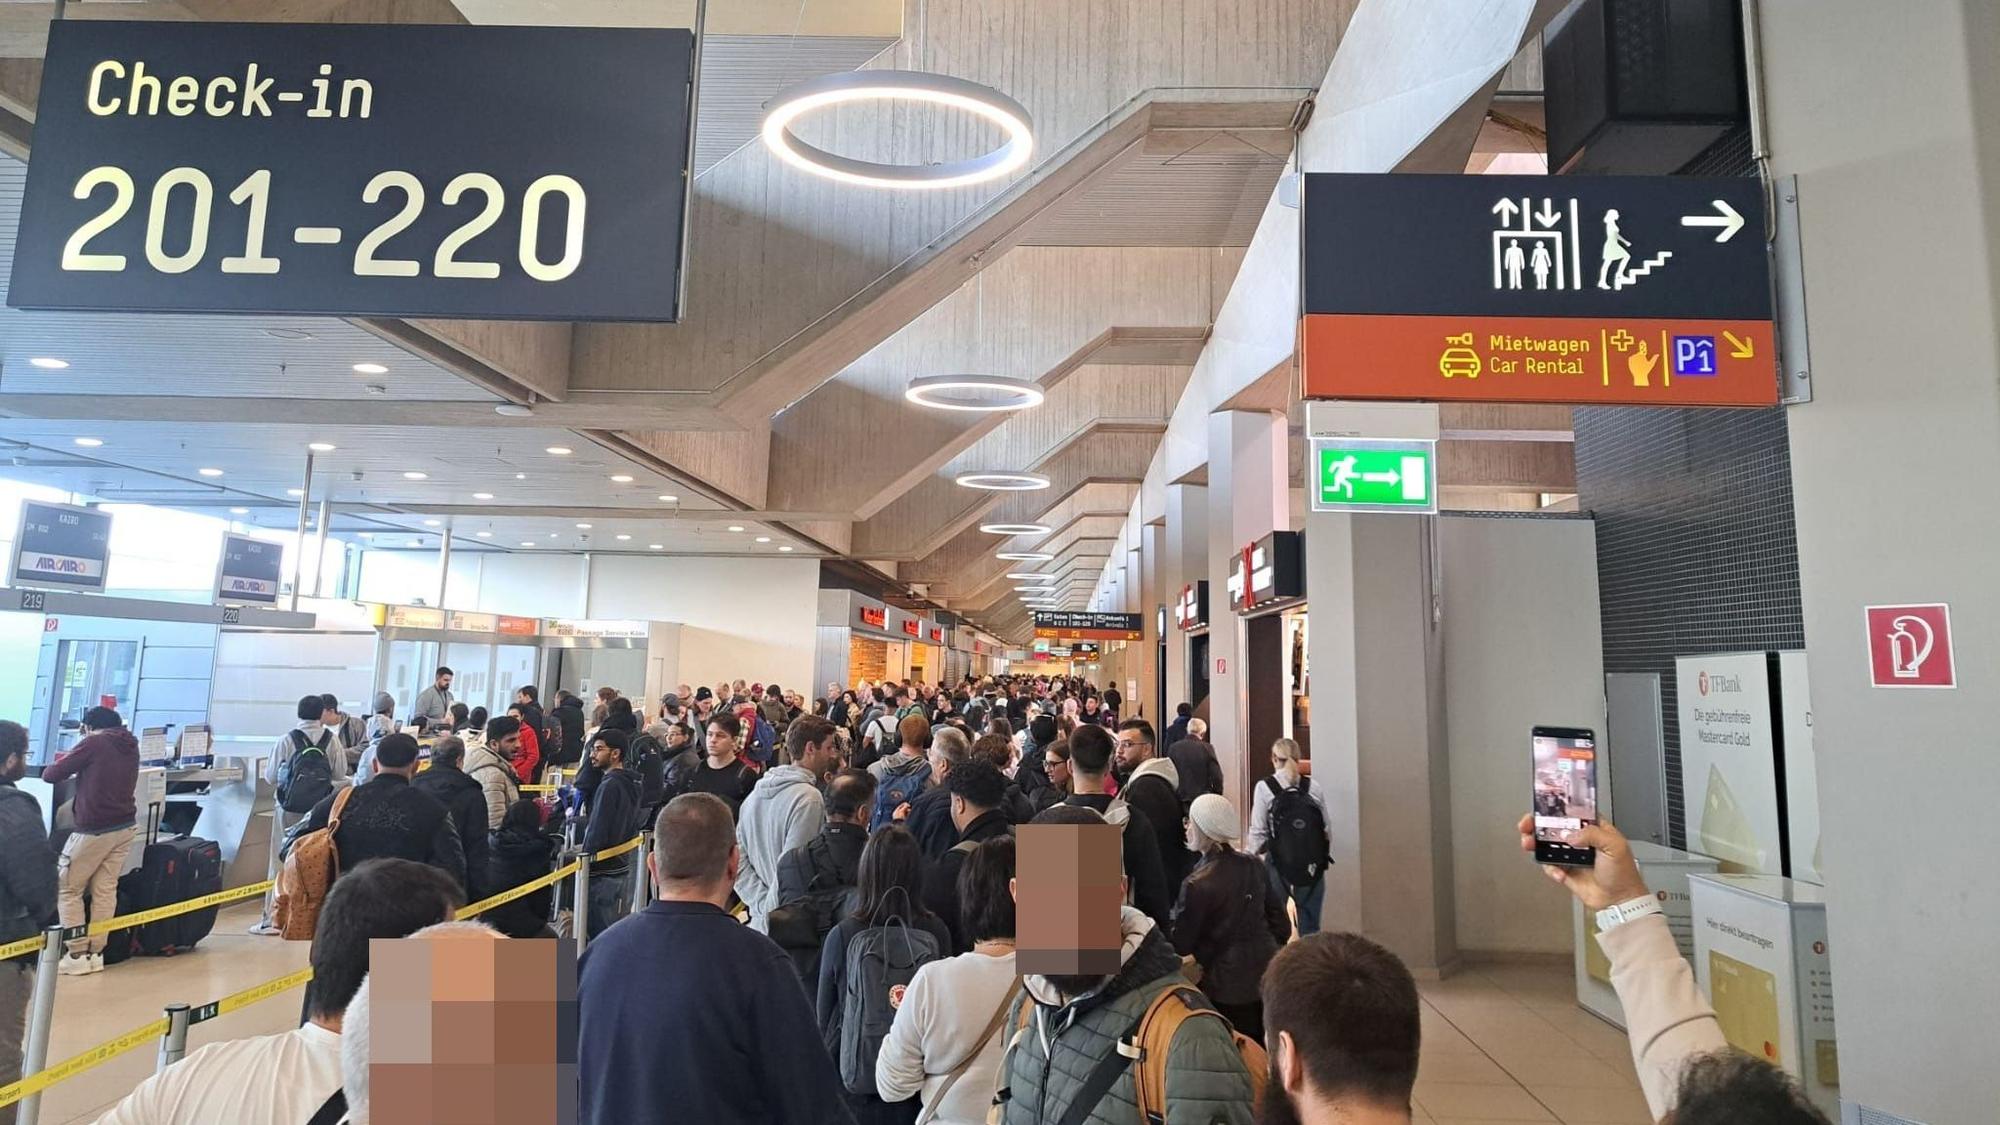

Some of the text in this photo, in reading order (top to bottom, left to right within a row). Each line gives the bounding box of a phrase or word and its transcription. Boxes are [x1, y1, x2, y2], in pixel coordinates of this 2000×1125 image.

[87, 60, 374, 119] Check-in
[60, 165, 588, 283] 201-220
[1489, 334, 1591, 355] Mietwagen
[1489, 357, 1585, 374] Car Rental
[59, 513, 79, 526] KAIRO
[23, 593, 42, 609] 219
[225, 608, 239, 622] 220
[1694, 708, 1704, 721] Die
[1699, 729, 1751, 746] Mastercard Gold
